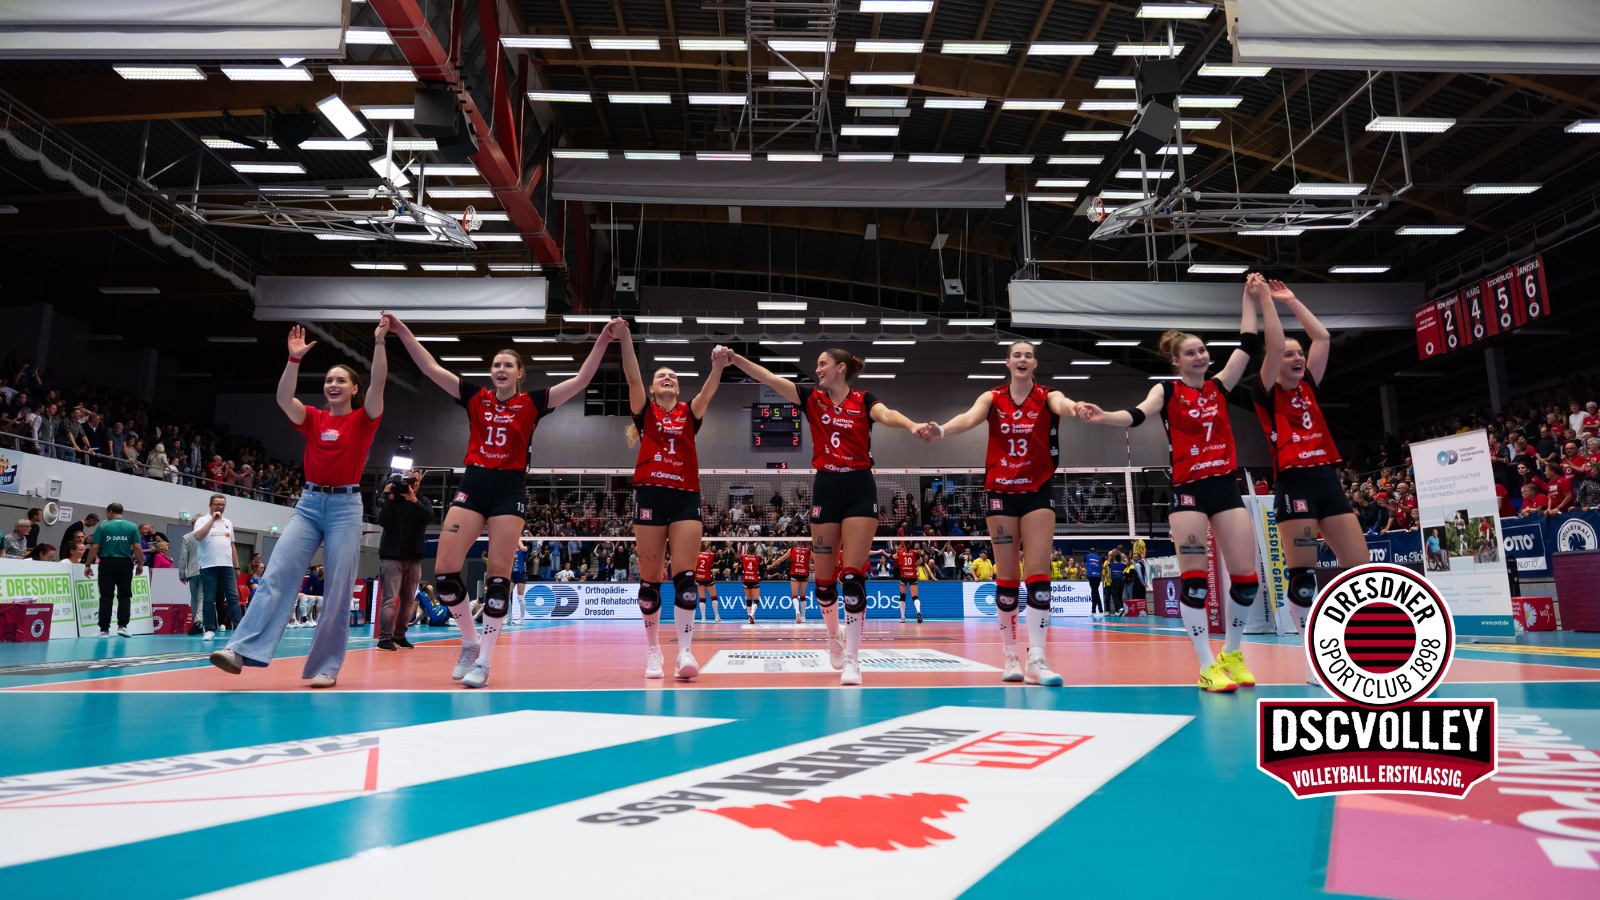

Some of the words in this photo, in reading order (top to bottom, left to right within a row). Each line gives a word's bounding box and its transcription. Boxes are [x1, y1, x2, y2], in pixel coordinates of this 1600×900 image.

[1525, 274, 1537, 298] 6
[1497, 286, 1509, 310] 5
[1471, 298, 1482, 320] 4
[1444, 310, 1455, 332] 2
[761, 408, 770, 417] 15
[773, 408, 780, 417] 5
[791, 408, 798, 417] 6
[1302, 411, 1313, 430] 8
[485, 426, 507, 447] 15
[755, 436, 761, 445] 3
[792, 436, 799, 445] 2
[830, 431, 840, 449] 6
[1202, 421, 1214, 443] 7
[667, 438, 676, 455] 1
[1007, 438, 1028, 457] 13
[873, 503, 878, 513] 6
[1561, 524, 1591, 541] VOLLEYBALL
[1503, 534, 1534, 552] OTTO
[903, 557, 913, 566] 10
[1368, 548, 1386, 562] TTO
[1394, 553, 1408, 563] Das
[700, 560, 706, 569] 2
[747, 562, 753, 570] 4
[6, 577, 70, 597] DRESDNER
[79, 581, 96, 600] DIE
[585, 586, 628, 595] Orthopädie-
[585, 597, 599, 605] und
[601, 597, 639, 606] Rehatechn
[584, 608, 615, 616] Dresden
[693, 726, 981, 796] KÜCHEN
[577, 789, 726, 828] ASS
